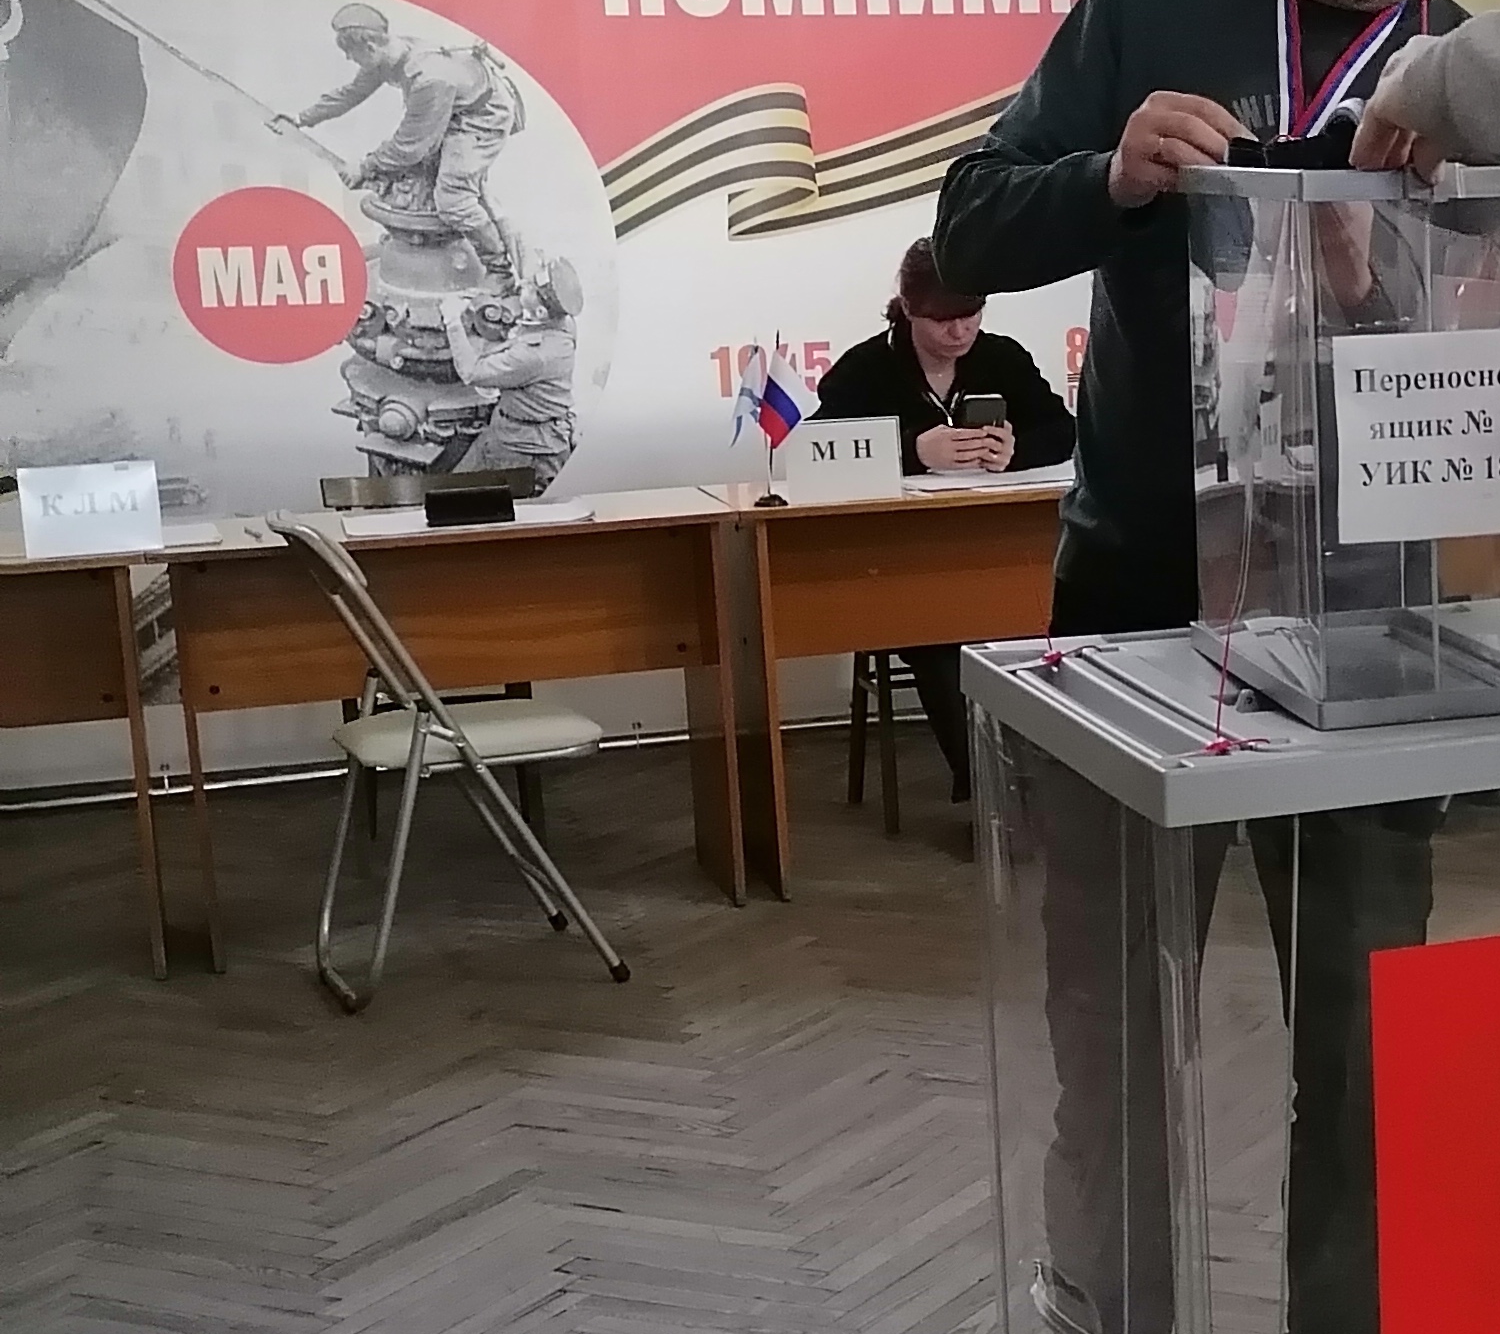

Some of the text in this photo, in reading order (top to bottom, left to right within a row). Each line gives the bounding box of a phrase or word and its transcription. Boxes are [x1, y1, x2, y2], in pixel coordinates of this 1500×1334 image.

[196, 244, 346, 309] МАЯ
[1369, 418, 1453, 441] ящик
[1461, 409, 1493, 435] №
[1359, 459, 1433, 487] УИК
[1441, 457, 1474, 483] №
